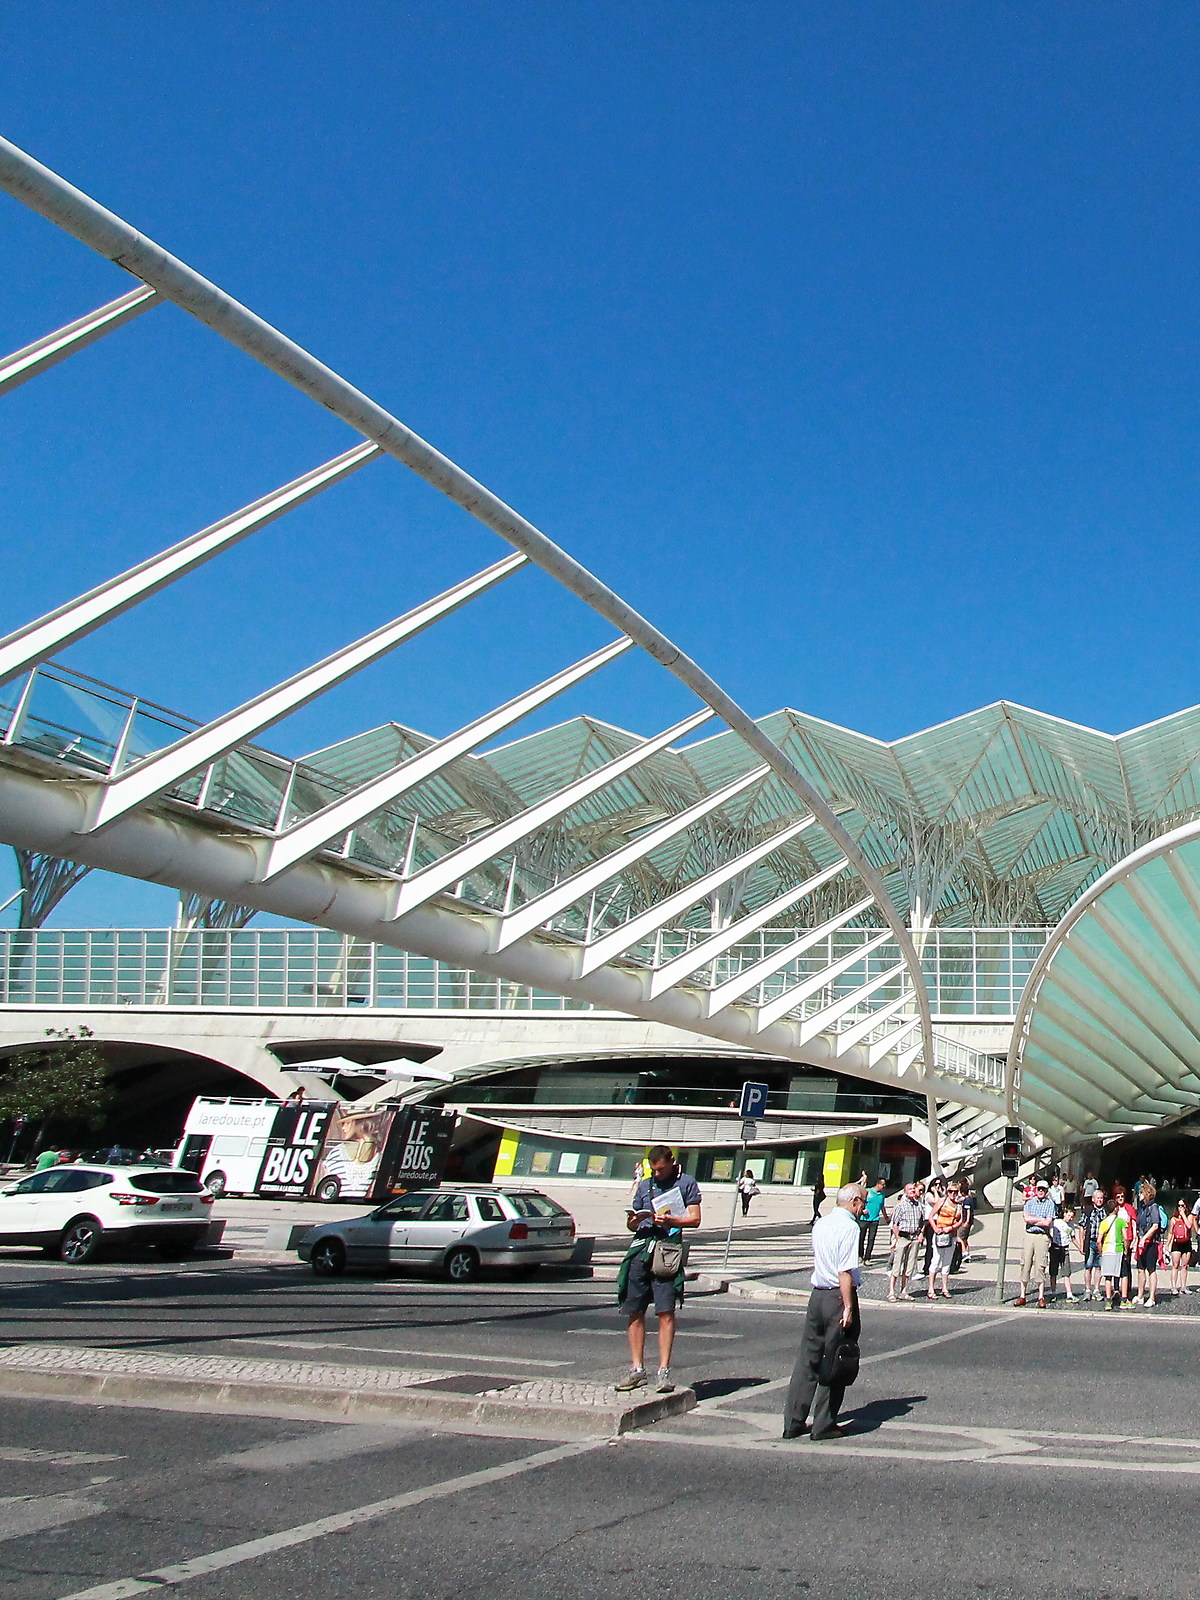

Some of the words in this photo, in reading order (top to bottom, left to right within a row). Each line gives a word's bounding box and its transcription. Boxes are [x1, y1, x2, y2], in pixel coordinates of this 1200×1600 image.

[747, 1088, 762, 1112] P
[198, 1113, 266, 1129] laredoute.pt
[292, 1112, 328, 1146] LE
[407, 1120, 430, 1145] LE
[262, 1147, 314, 1184] BUS
[400, 1145, 434, 1170] BUS
[398, 1170, 438, 1181] laredoute.pt
